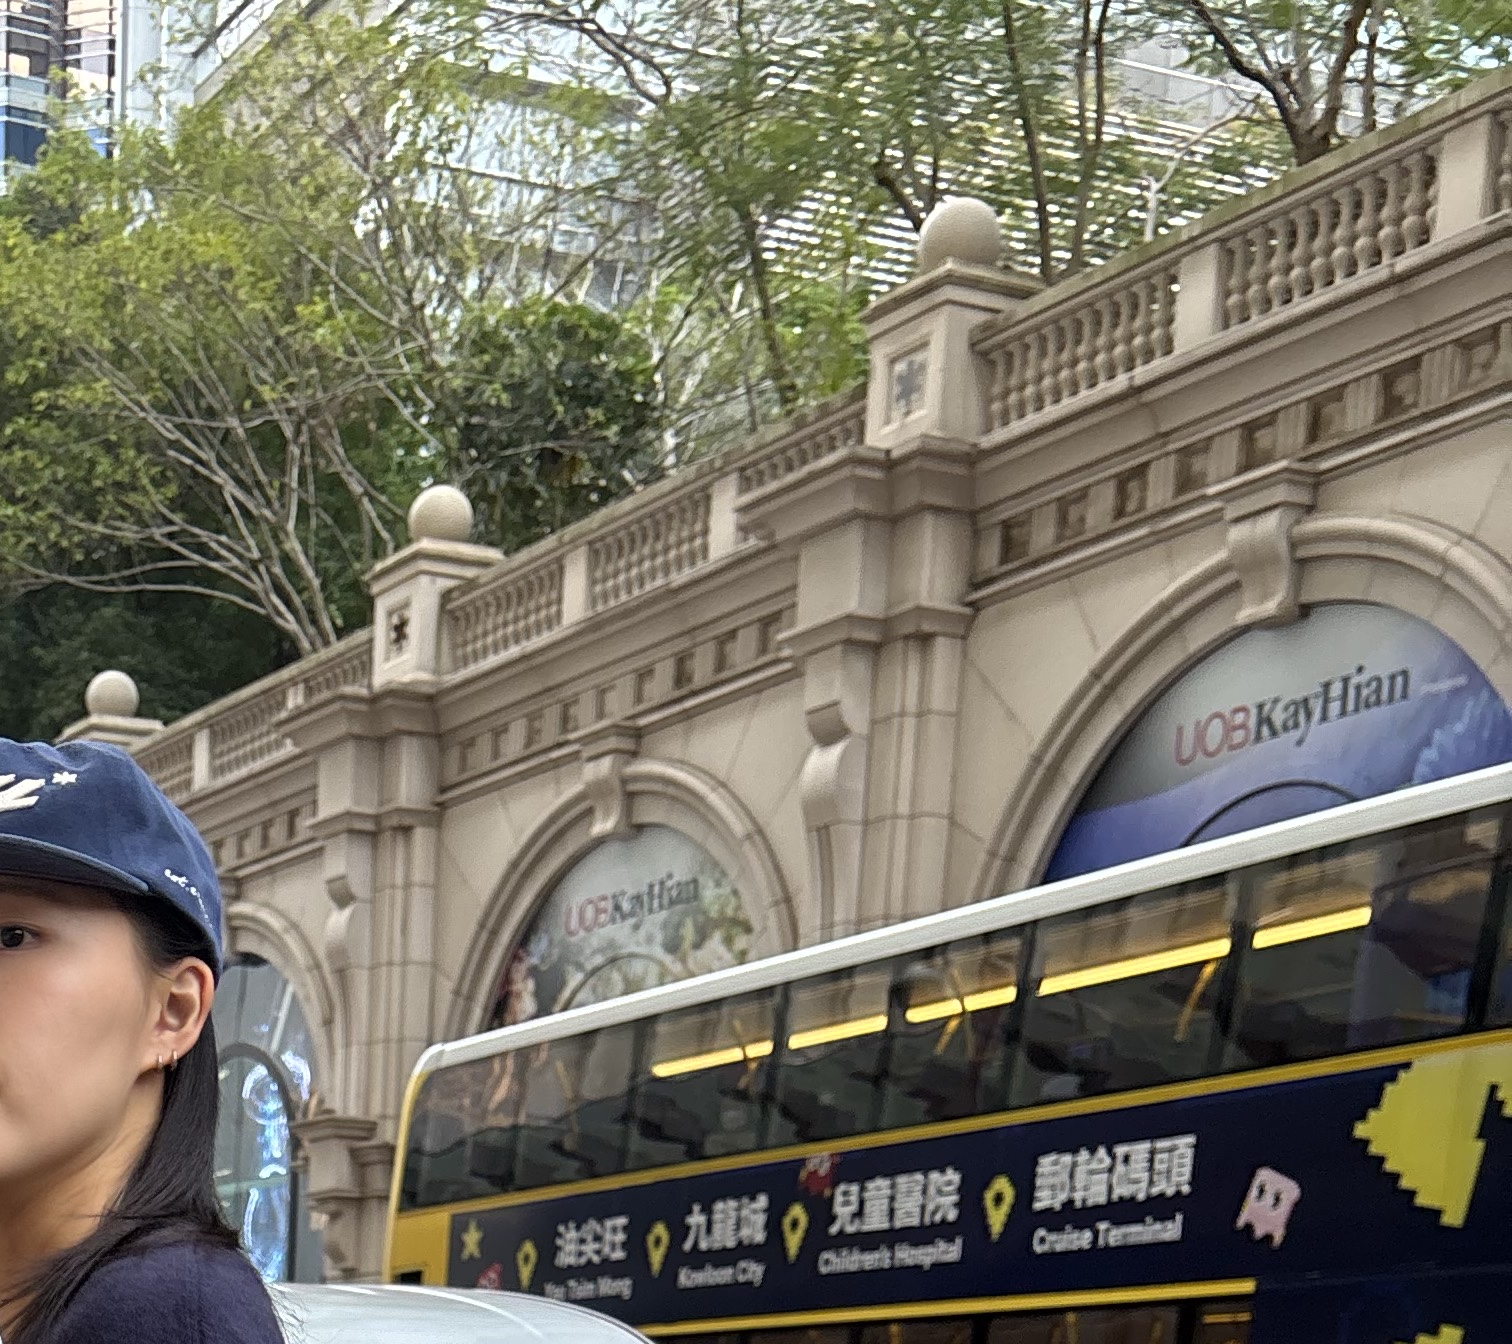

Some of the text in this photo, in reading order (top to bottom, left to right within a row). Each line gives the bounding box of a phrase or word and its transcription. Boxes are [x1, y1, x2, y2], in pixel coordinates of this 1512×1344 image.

[1174, 664, 1412, 767] UOBKayHian
[682, 1192, 770, 1253] 九龍城
[828, 1166, 963, 1236] 兒童醫院
[1032, 1134, 1197, 1212] 郵輪碼頭
[677, 1264, 735, 1290] Kowloon
[736, 1258, 767, 1288] City
[818, 1242, 891, 1276] Children's
[893, 1236, 963, 1271] Hospital
[1032, 1222, 1093, 1255] Cruise
[1095, 1212, 1184, 1250] Terminal
